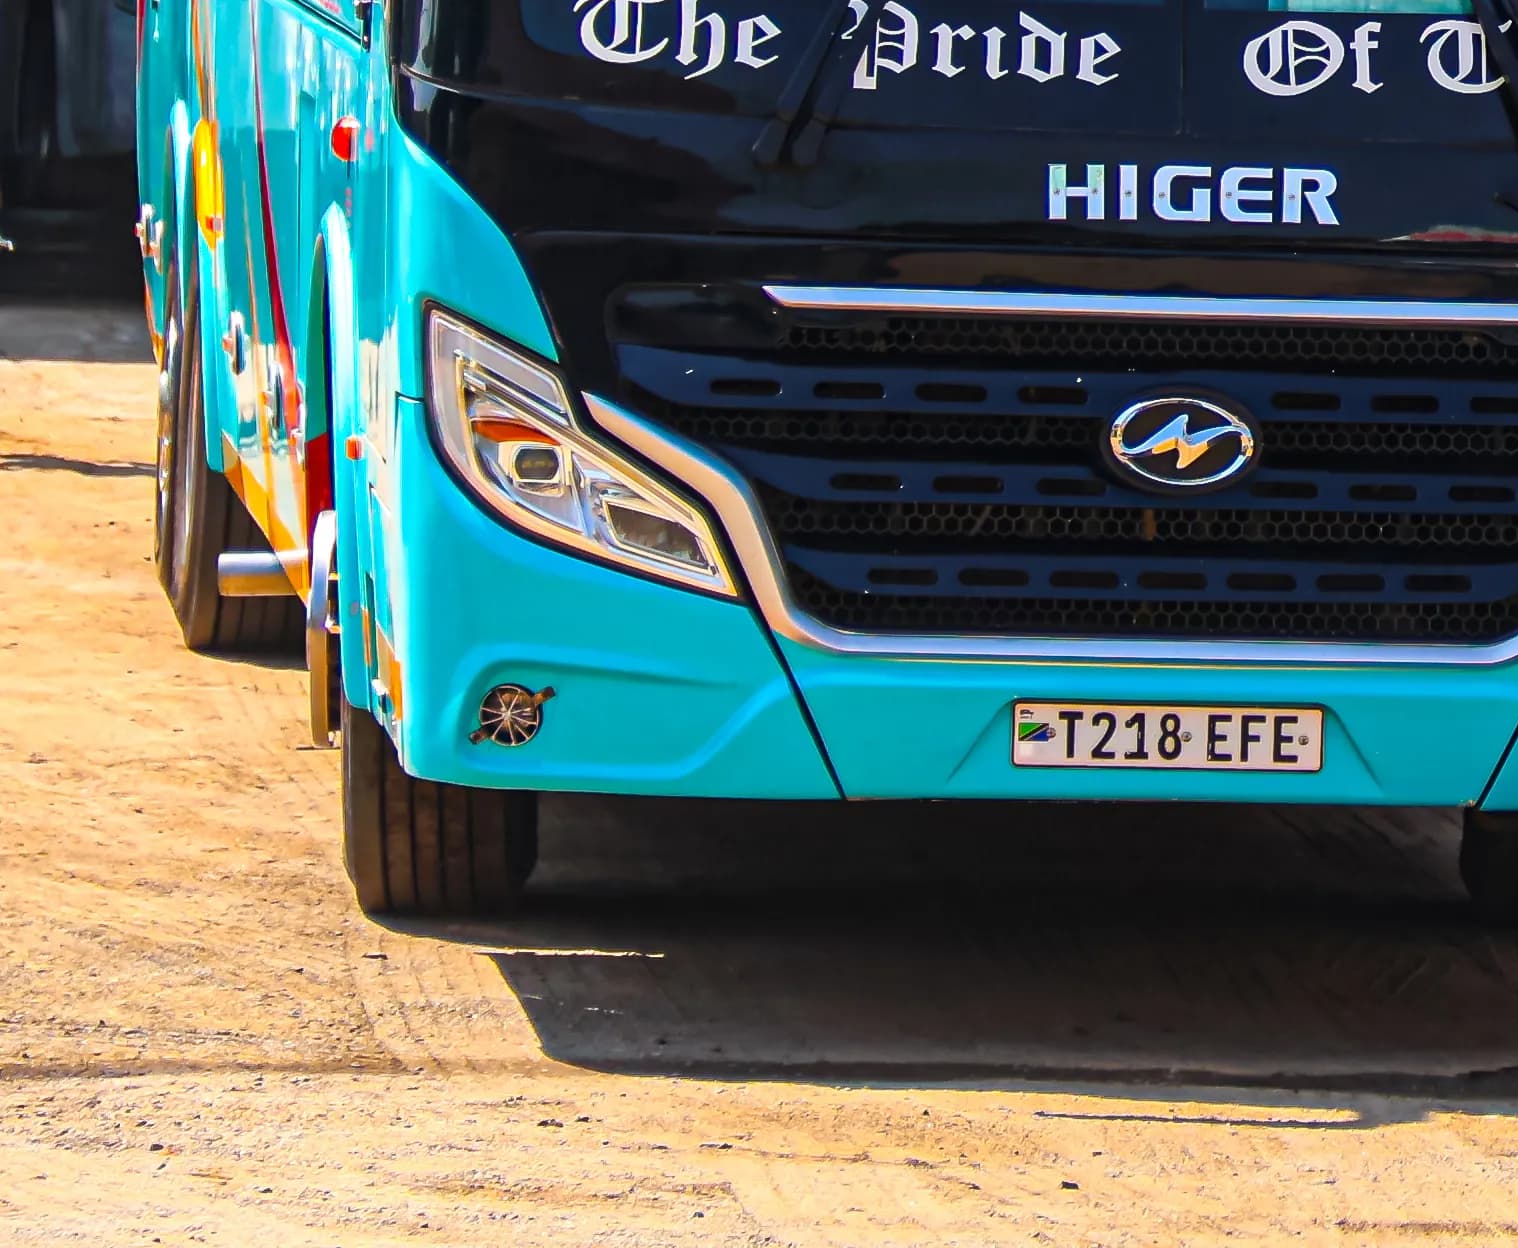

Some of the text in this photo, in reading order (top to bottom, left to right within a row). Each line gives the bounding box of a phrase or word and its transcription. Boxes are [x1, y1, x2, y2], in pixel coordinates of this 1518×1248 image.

[1243, 20, 1384, 97] Of
[1047, 163, 1340, 226] HIGER
[1057, 711, 1300, 763] T218 EFE
